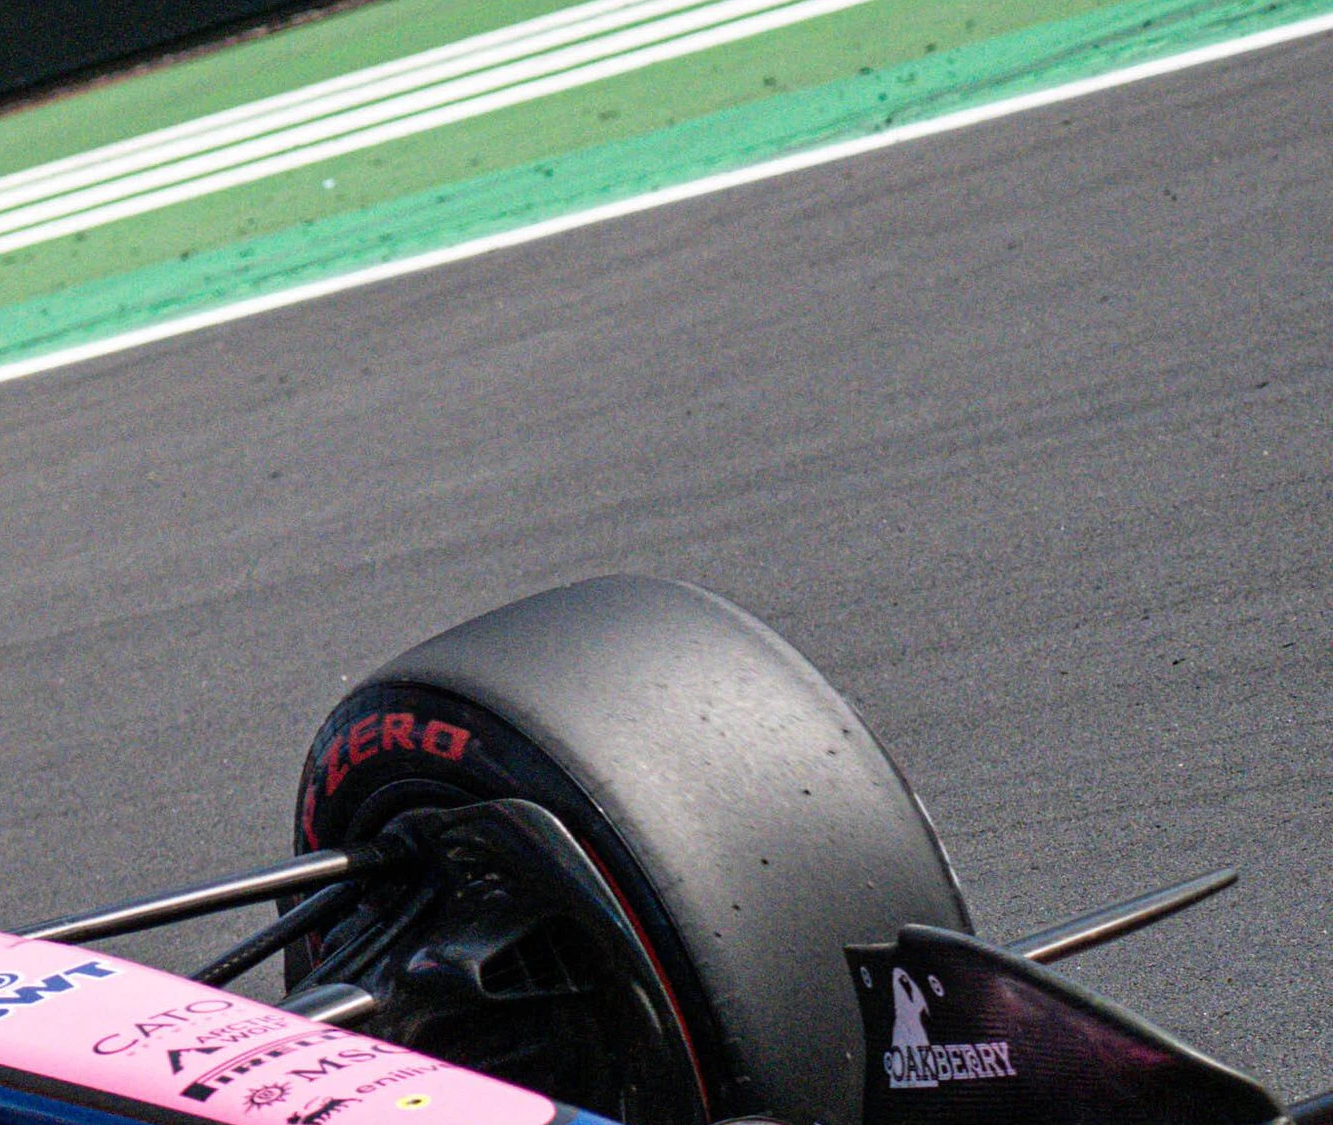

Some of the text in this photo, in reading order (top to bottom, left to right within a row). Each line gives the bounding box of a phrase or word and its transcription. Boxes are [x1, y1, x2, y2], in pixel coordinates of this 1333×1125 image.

[322, 712, 471, 796] ZERO
[92, 999, 233, 1056] CATO
[888, 1042, 1018, 1082] OAKBERRY
